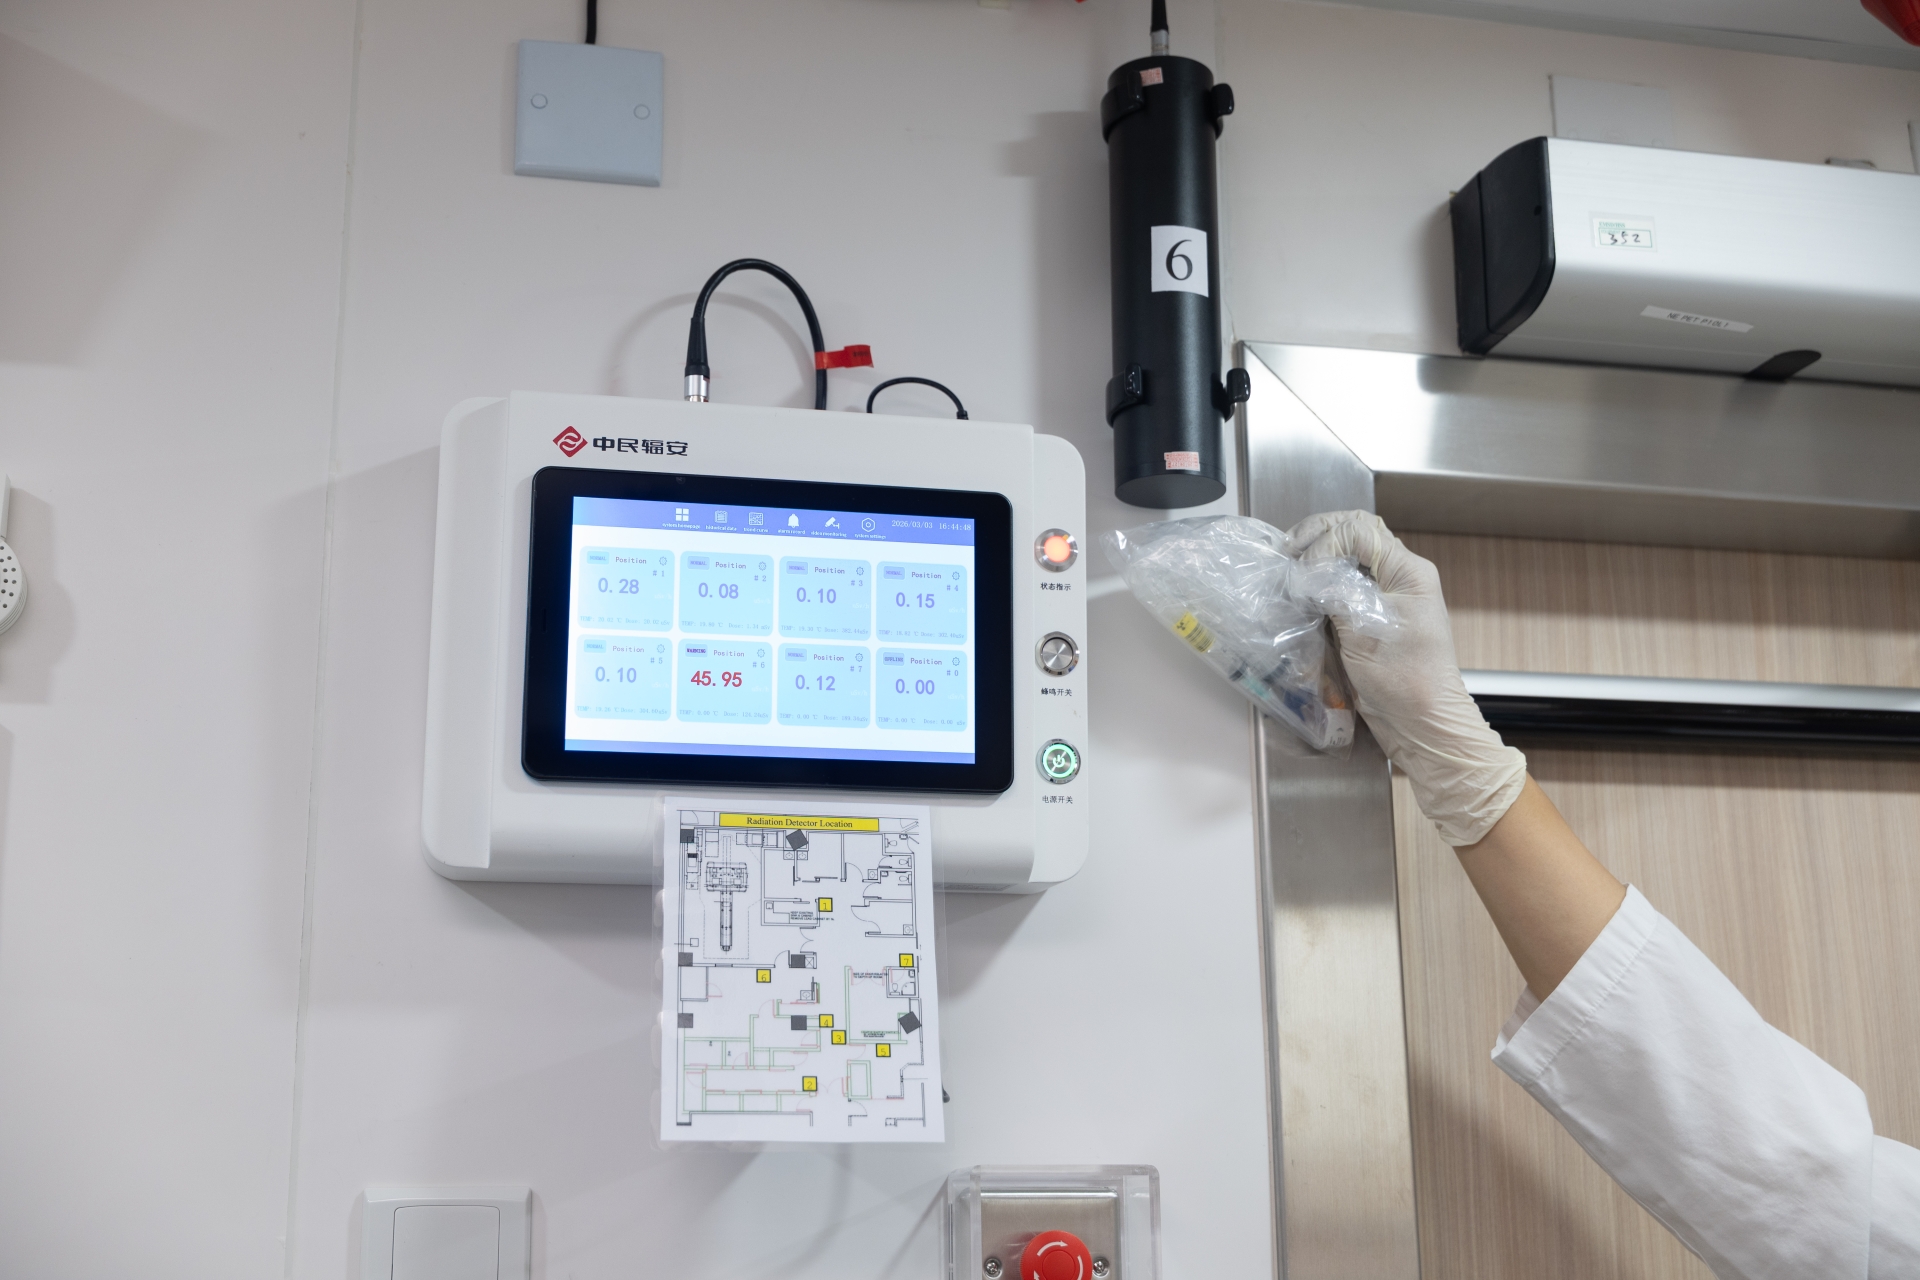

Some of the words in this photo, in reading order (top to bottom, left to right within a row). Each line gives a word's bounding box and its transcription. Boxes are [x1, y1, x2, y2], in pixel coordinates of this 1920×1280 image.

[1608, 231, 1640, 245] 352
[1164, 238, 1193, 281] 6
[593, 436, 688, 457] 中民辐安
[892, 520, 933, 529] 2026/03/03
[939, 523, 972, 531] 16:44:48
[615, 556, 647, 565] Position
[715, 562, 747, 570] Position
[814, 566, 845, 575] Position
[598, 577, 640, 595] 0.28
[698, 582, 739, 600] 0.08
[1040, 582, 1072, 591] 状态指示
[796, 587, 837, 604] 0.10
[896, 592, 935, 609] 0.15
[713, 650, 745, 658] Position
[910, 657, 943, 666] Position
[595, 666, 637, 683] 0.10
[690, 670, 742, 688] 45.95
[795, 674, 836, 692] 0.12
[895, 678, 935, 695] 0.00
[1041, 688, 1072, 696] 蜂鸣开关
[1042, 796, 1073, 804] 电源开关
[747, 817, 783, 826] Radiation
[786, 818, 818, 827] Detector
[761, 973, 766, 982] 6
[836, 1034, 841, 1043] 3
[881, 1048, 886, 1056] 5
[807, 1081, 812, 1089] 2
